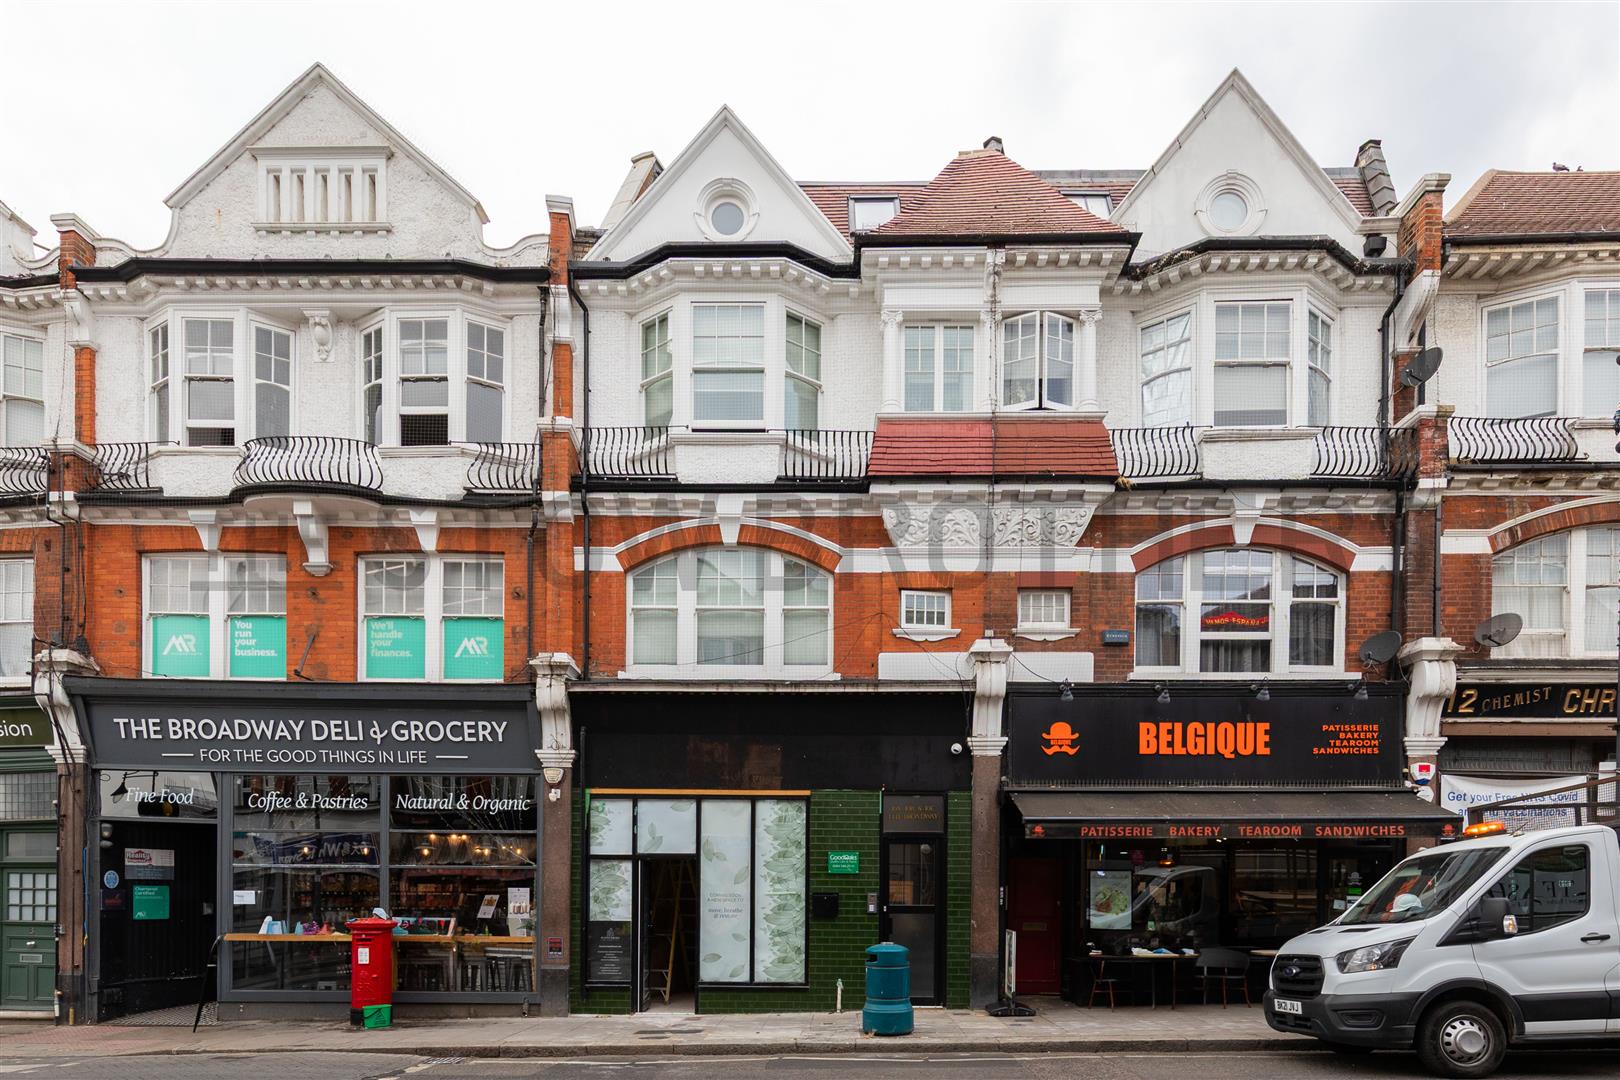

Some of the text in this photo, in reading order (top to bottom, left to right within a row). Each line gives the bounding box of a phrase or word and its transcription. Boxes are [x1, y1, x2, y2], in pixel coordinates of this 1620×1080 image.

[235, 620, 252, 629] You
[371, 622, 394, 630] We'll
[371, 630, 402, 639] handle
[235, 638, 257, 647] your
[371, 639, 393, 648] your
[235, 648, 278, 656] business.
[371, 649, 413, 657] finances.
[1481, 687, 1552, 712] CHEMIST
[113, 718, 163, 740] THE
[168, 718, 305, 742] BROADWAY
[311, 719, 364, 742] DELI
[391, 720, 508, 743] GROCERY
[1138, 722, 1271, 759] BELGIQUE
[1329, 739, 1379, 747] TEAROOM
[200, 749, 428, 764] FOR THE GOOD THINGS IN LIFE
[125, 786, 195, 805] Fine Food
[1447, 791, 1467, 802] Get
[1470, 793, 1492, 804] your
[248, 791, 368, 813] Coffee & Pastries
[395, 792, 531, 815] Natural & Organic
[1080, 825, 1405, 837] PATISSERIE BAKERY TEAROOM SANDWICHES
